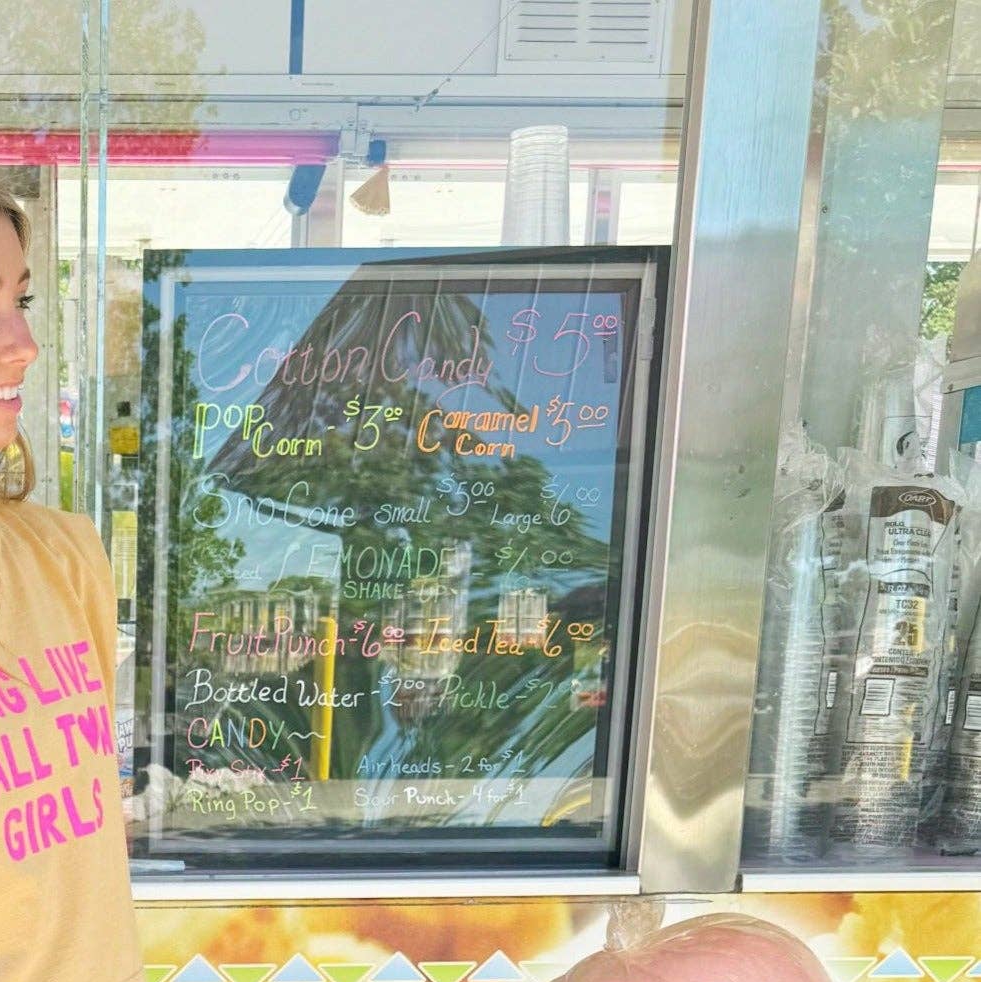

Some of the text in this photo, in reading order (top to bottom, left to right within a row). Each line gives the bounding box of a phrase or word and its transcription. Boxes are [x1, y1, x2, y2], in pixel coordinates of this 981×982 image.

[198, 313, 368, 392] Cotton
[381, 311, 494, 409] Candy
[252, 421, 322, 458] Corn
[418, 405, 539, 452] Caramel
[455, 433, 516, 458] Corn
[193, 473, 275, 529] Sno
[284, 481, 356, 527] Cone
[490, 504, 543, 533] Large
[888, 528, 914, 536] ULTRA
[269, 542, 456, 597] LEMONADE
[189, 612, 268, 656] Fruit
[420, 617, 480, 654] Iced
[892, 620, 919, 646] 25
[18, 640, 102, 705] LIVE
[185, 668, 287, 710] Bottled
[296, 680, 364, 708] Water
[437, 673, 510, 709] Pickle
[187, 717, 285, 750] CANDY
[461, 756, 475, 773] 2
[478, 758, 500, 772] for
[502, 749, 526, 773] $1
[4, 777, 103, 861] GIRLS
[186, 788, 236, 820] Ring
[291, 782, 318, 812] $1
[354, 787, 398, 808] Sour
[473, 784, 482, 802] 4
[488, 788, 507, 801] for
